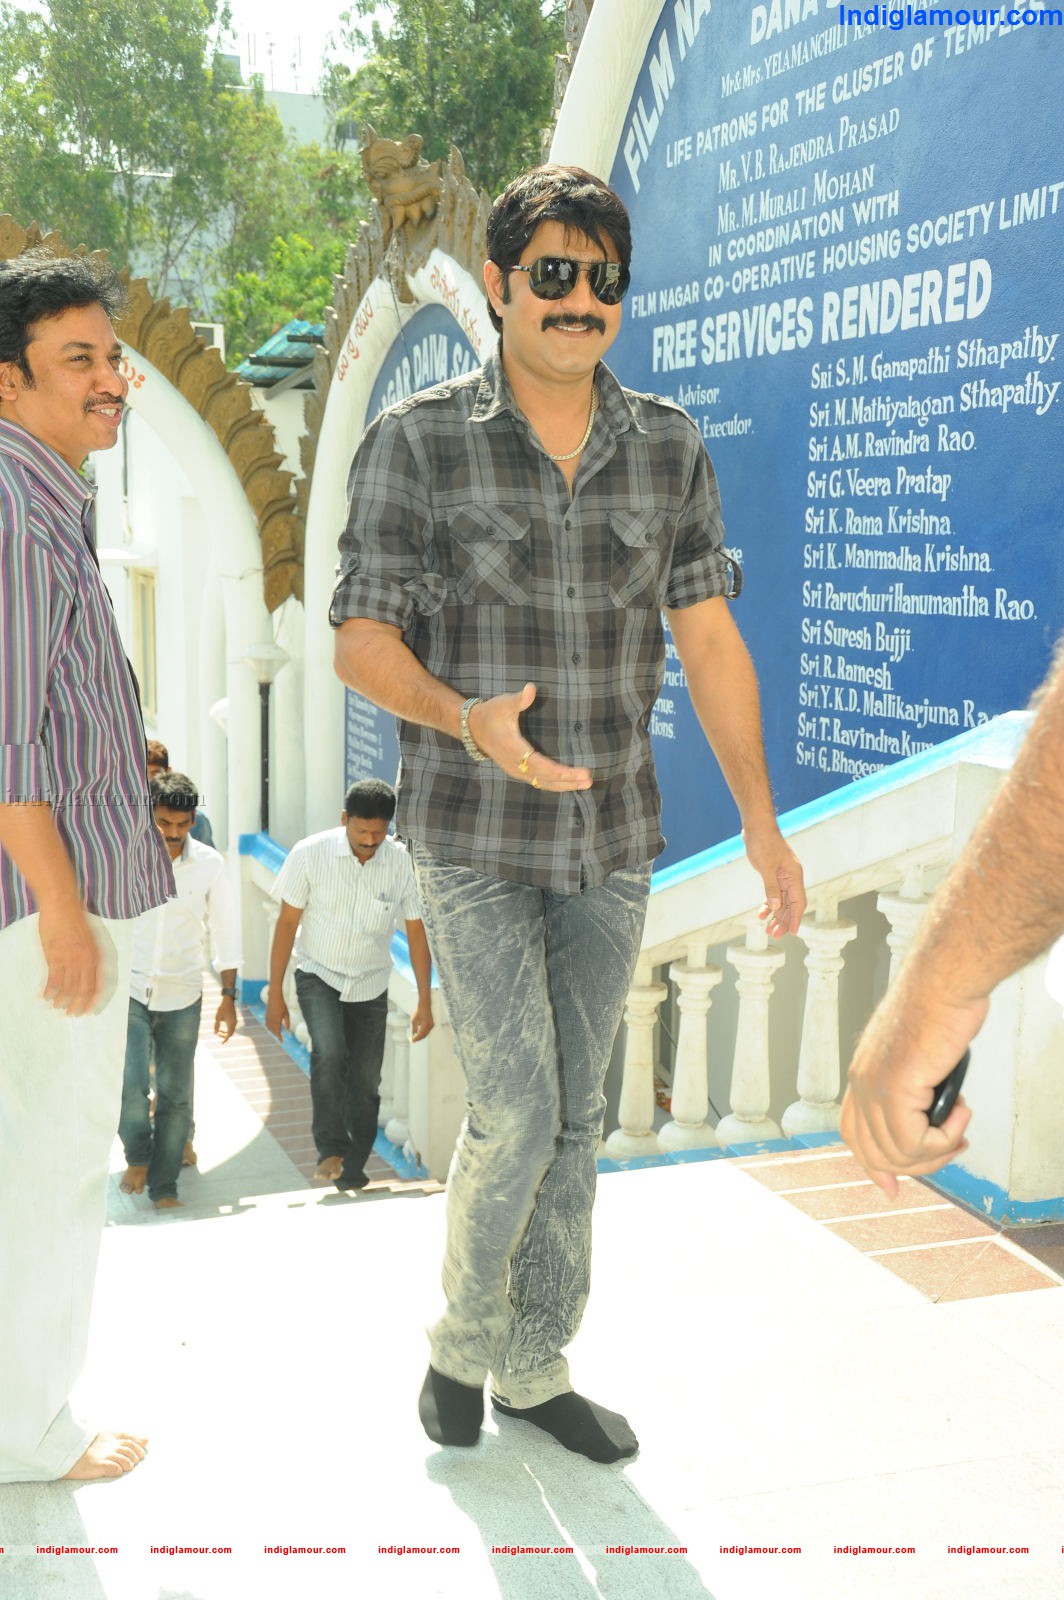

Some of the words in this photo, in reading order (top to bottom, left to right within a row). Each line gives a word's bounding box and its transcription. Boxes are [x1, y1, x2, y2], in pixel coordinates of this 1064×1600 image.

[624, 28, 675, 195] FILM
[666, 136, 692, 169] LIFE
[696, 111, 758, 157] PATRONS
[761, 98, 789, 132] FOR
[795, 82, 827, 117] THE
[831, 50, 905, 104] CLUSTER
[910, 37, 935, 71] OF
[769, 132, 835, 176] RAJENDRA
[838, 107, 900, 152] PRASAD
[812, 164, 876, 206] MOHAN
[708, 244, 722, 268] IN
[727, 207, 844, 262] COORDINATION
[852, 190, 900, 227] WITH
[631, 291, 656, 319] FILM
[659, 281, 700, 313] NAGAR
[703, 250, 816, 301] CO-OPERATIVE
[823, 228, 901, 275] HOUSING
[906, 201, 995, 253] SOCIETY
[652, 319, 697, 373] FREE
[701, 296, 814, 366] SERVICES
[821, 258, 992, 345] RENDERED
[412, 333, 448, 390] DAIVA
[871, 345, 951, 383] Ganapathi
[865, 429, 930, 458] Ravindra
[846, 467, 891, 496] Veera
[845, 506, 883, 536] Rama
[845, 542, 922, 573] Manmadha
[824, 619, 872, 651] Suresh
[863, 690, 960, 729] Mallikarjuna
